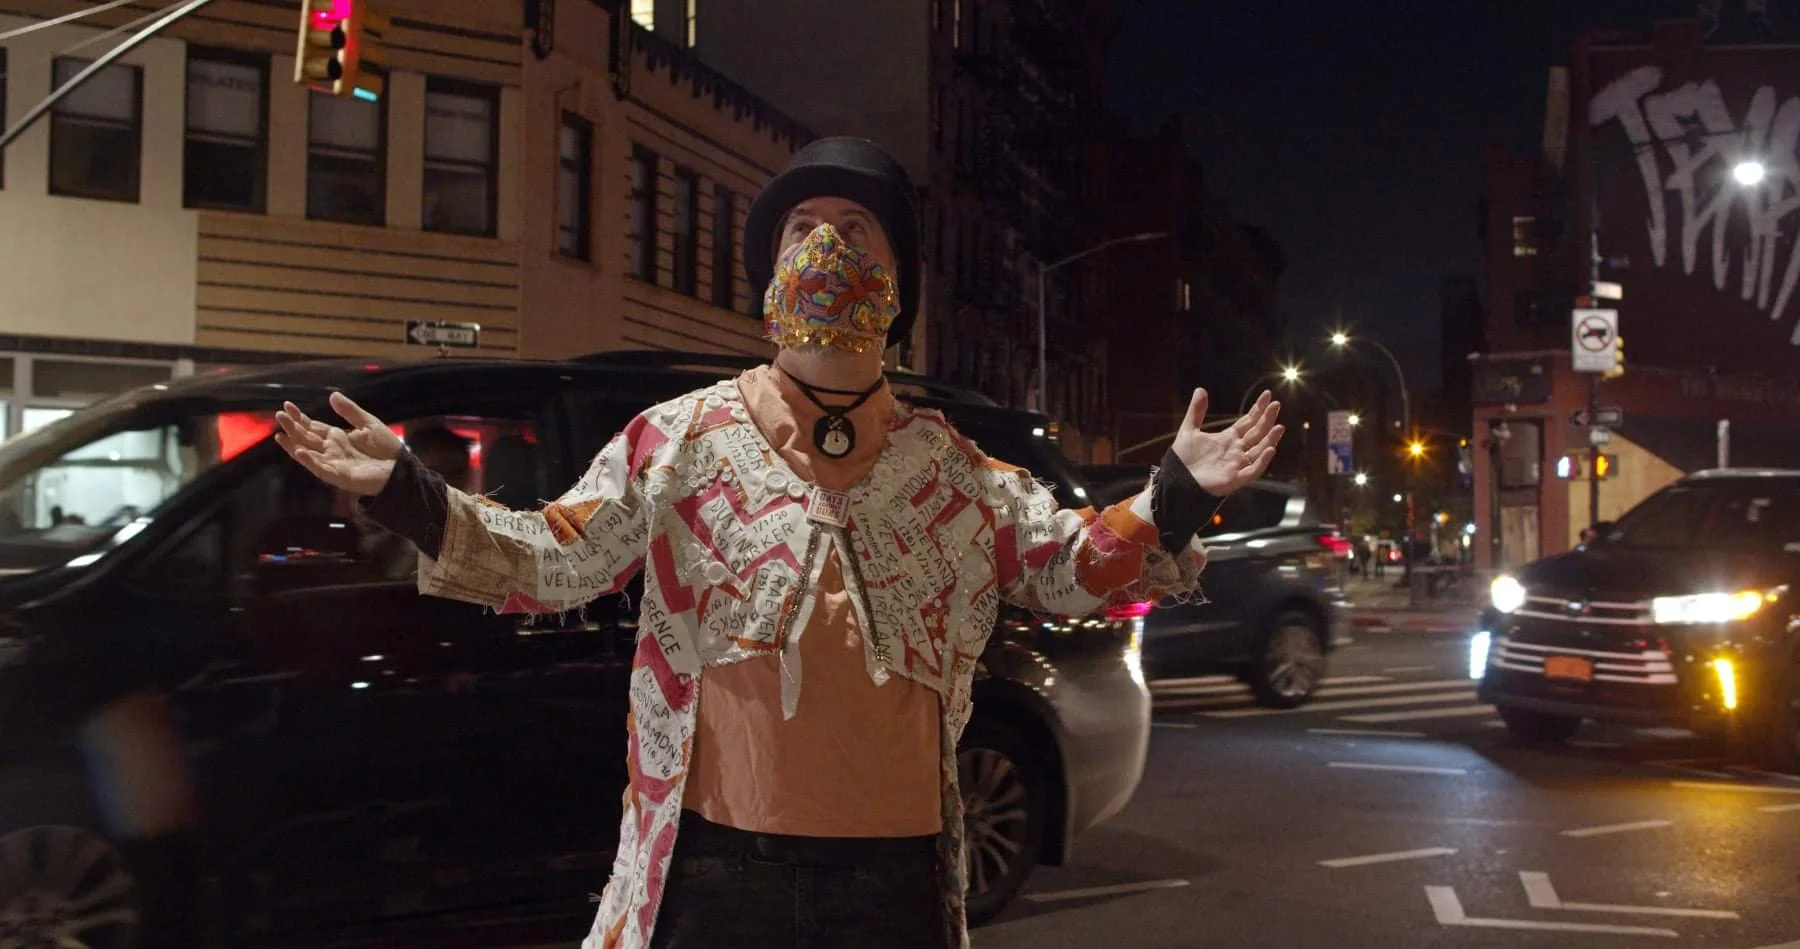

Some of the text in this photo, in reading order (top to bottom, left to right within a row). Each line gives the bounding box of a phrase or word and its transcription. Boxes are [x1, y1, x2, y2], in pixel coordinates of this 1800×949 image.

[483, 510, 551, 537] SERENA
[711, 499, 754, 553] DUSTIN
[757, 573, 788, 643] RAEVEN
[638, 713, 682, 767] IAMOND
